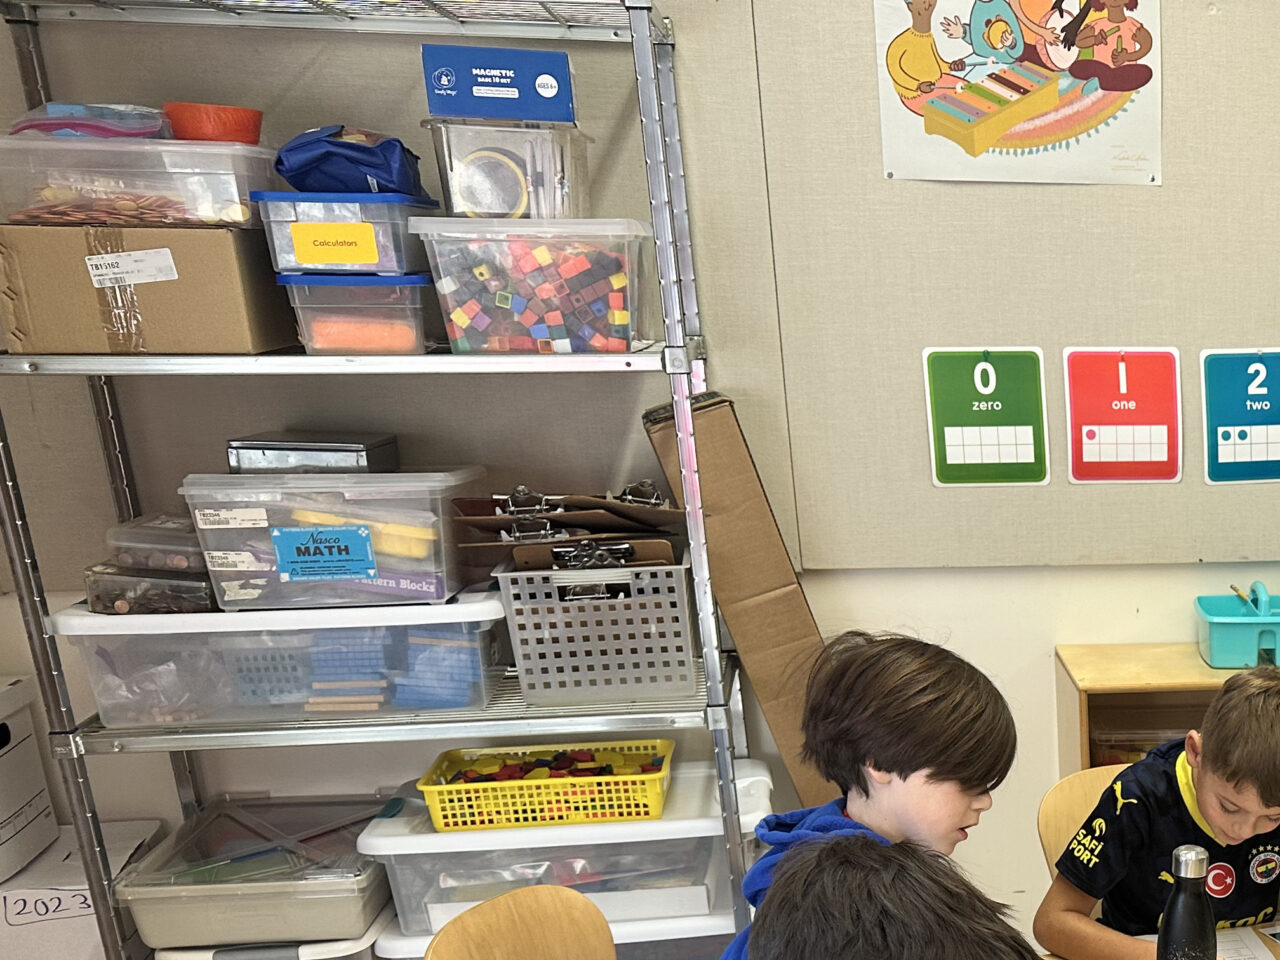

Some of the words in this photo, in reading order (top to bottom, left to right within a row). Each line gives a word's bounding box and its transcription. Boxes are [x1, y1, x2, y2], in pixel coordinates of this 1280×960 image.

[472, 68, 514, 77] MAGNETIC
[312, 239, 358, 247] Calculators
[973, 361, 997, 395] 0
[1118, 361, 1127, 394] 1
[1247, 362, 1268, 395] 2
[972, 401, 1002, 411] zero
[1112, 400, 1136, 410] one
[1246, 400, 1270, 410] two
[300, 531, 341, 545] Nasco
[296, 545, 350, 557] MATH
[400, 579, 436, 593] Blocks
[1069, 839, 1099, 868] PORT
[13, 894, 91, 917] 2023
